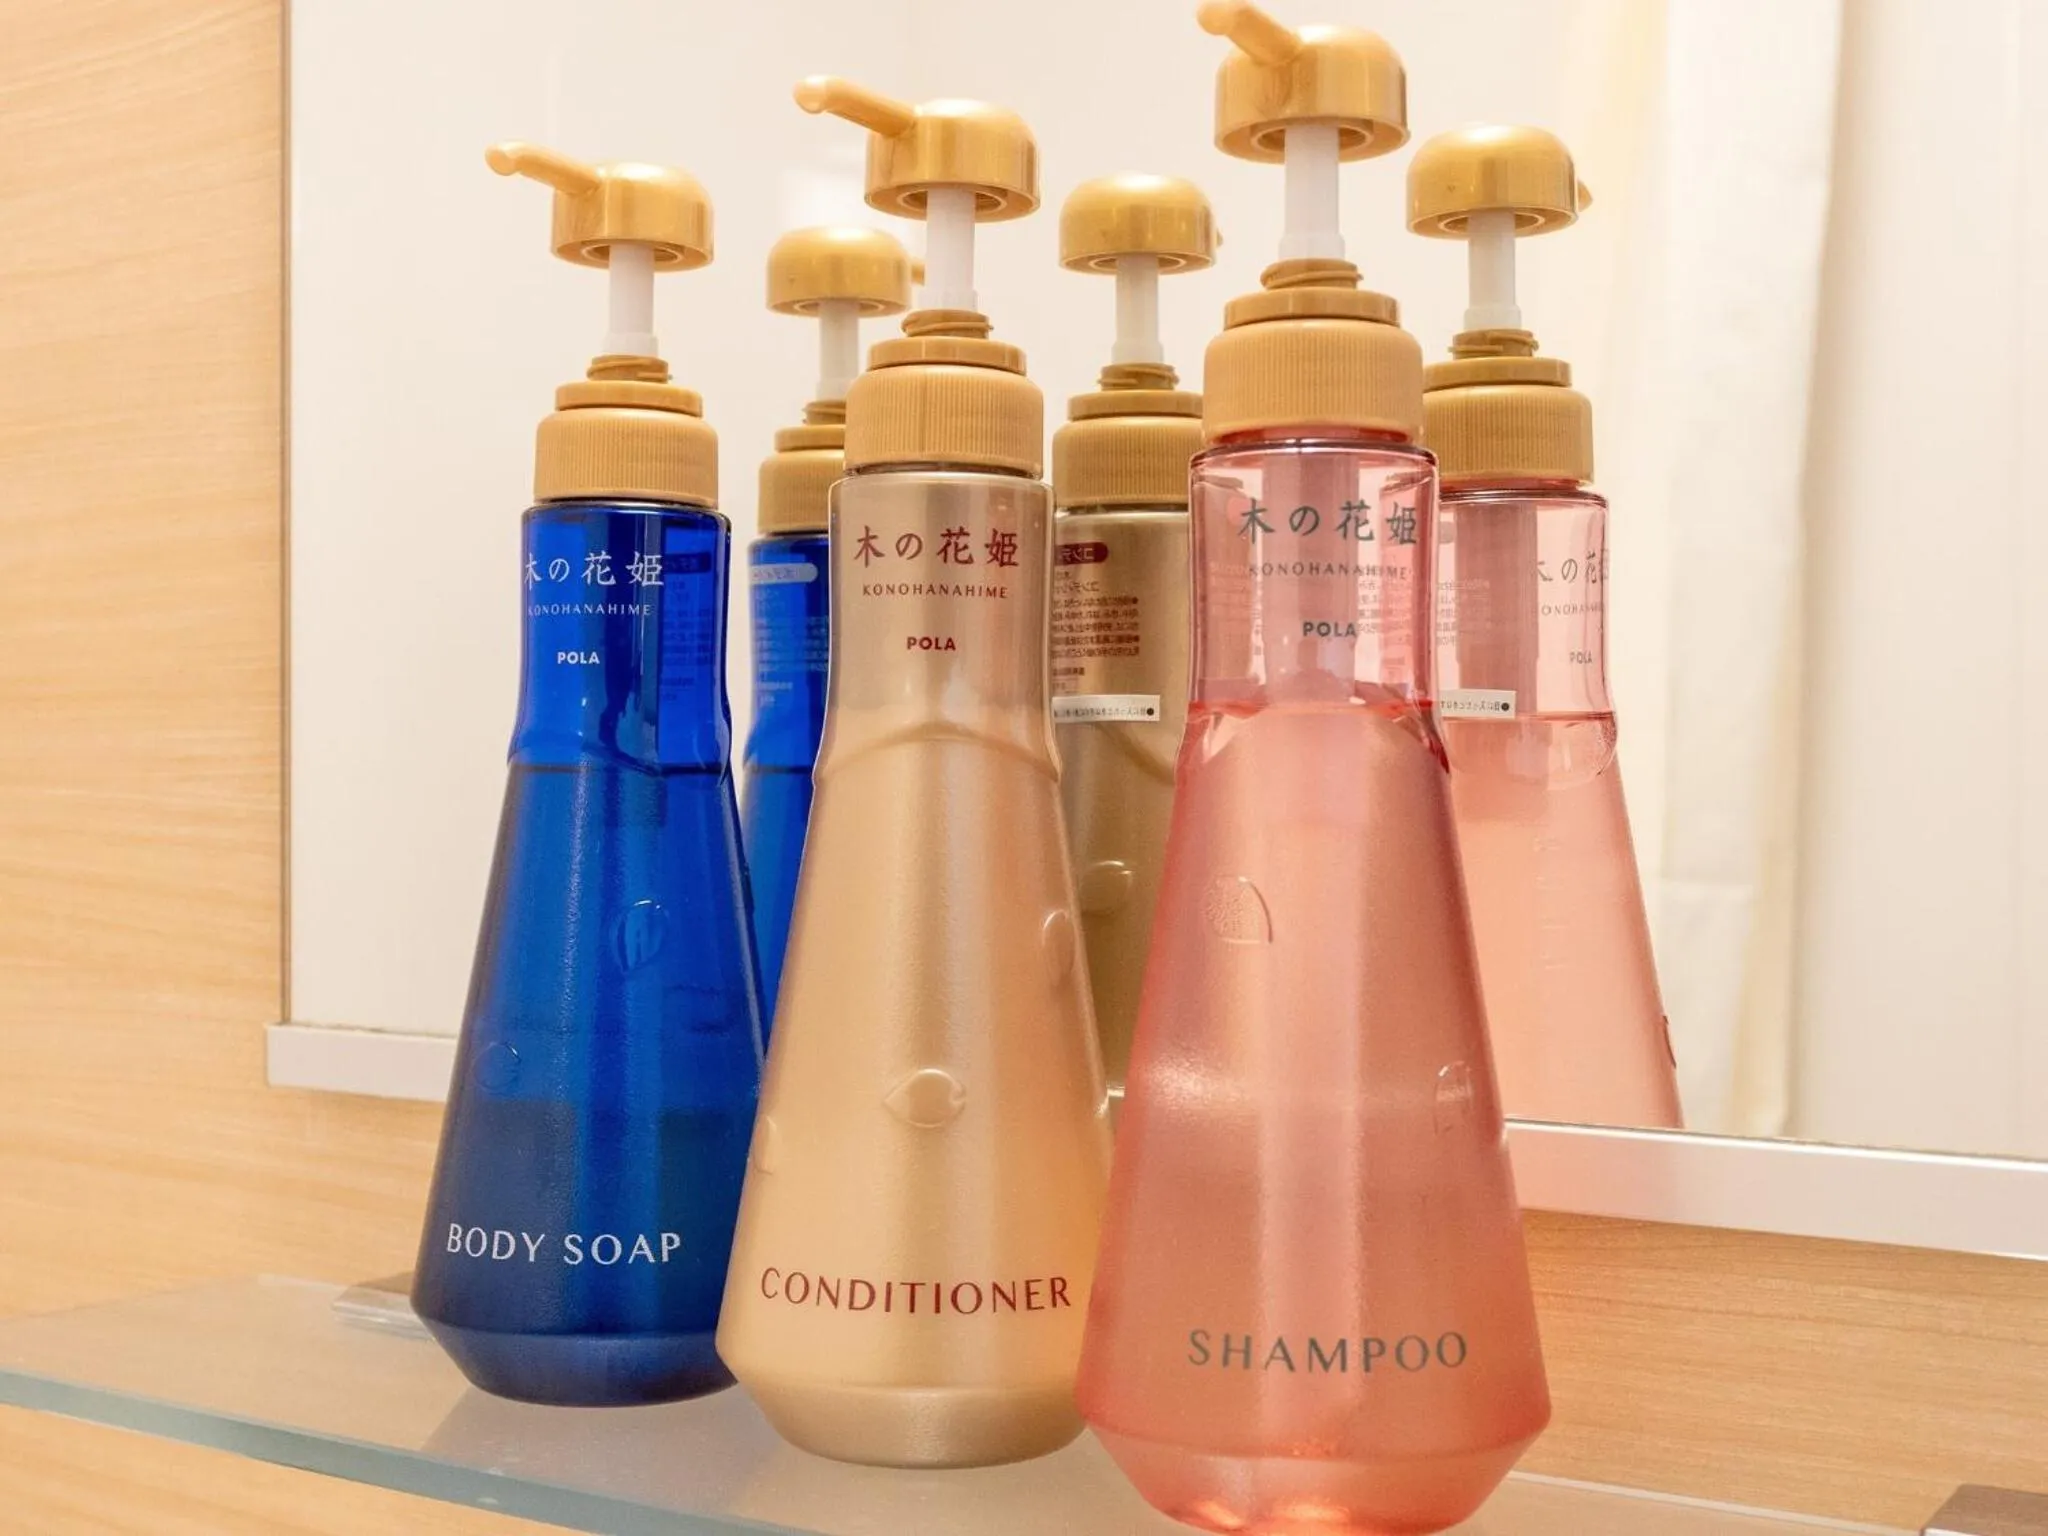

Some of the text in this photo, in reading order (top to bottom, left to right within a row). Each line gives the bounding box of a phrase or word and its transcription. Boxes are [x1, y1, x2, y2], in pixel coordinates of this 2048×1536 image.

[1238, 497, 1417, 546] 木の花姫
[854, 525, 1020, 568] 木の花姫
[524, 550, 665, 591] 木の花姫
[1249, 562, 1408, 580] KONOHANAHIME
[863, 583, 1009, 599] KONOHANAHIME
[528, 603, 652, 616] KONOHANAHIME
[906, 636, 957, 652] POLA
[1303, 621, 1357, 638] POLA
[557, 651, 600, 664] POLA
[446, 1223, 681, 1265] BODY SOAP
[761, 1267, 1071, 1314] CONDITIONER
[1187, 1329, 1467, 1373] SHAMPOO
